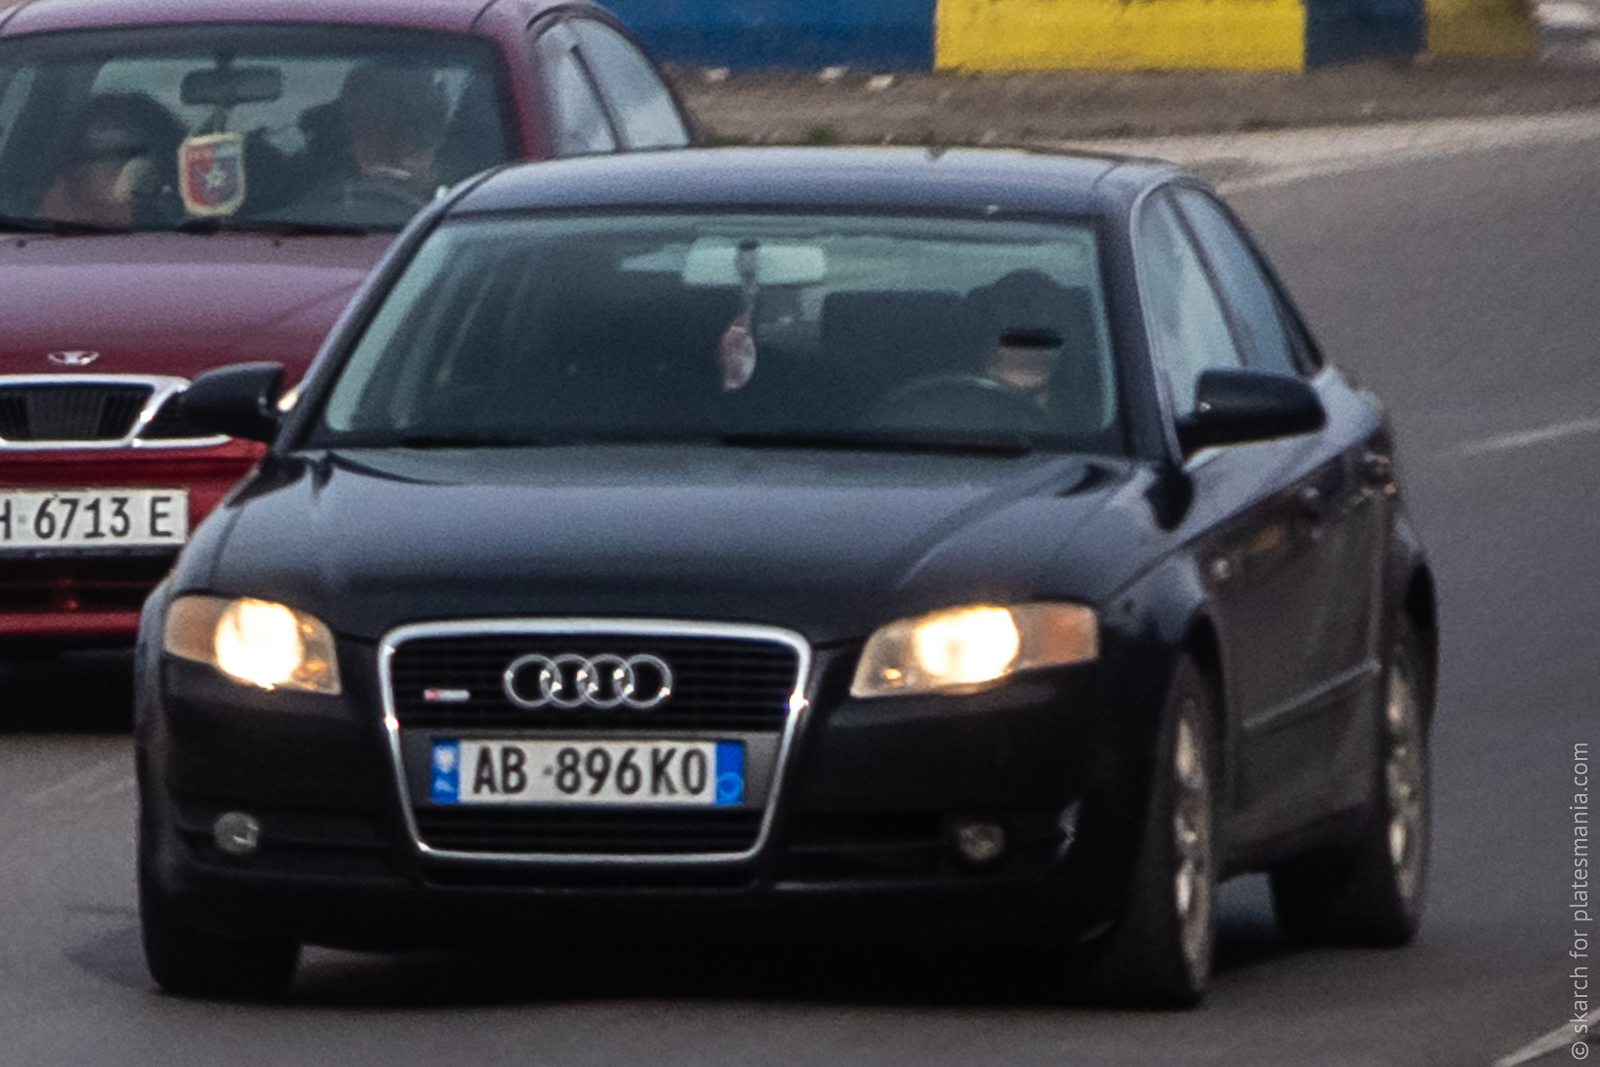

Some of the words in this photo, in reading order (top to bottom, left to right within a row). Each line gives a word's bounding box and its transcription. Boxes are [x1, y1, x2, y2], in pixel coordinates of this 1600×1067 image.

[34, 497, 130, 539] 6713
[151, 496, 172, 537] E
[473, 746, 528, 795] AB
